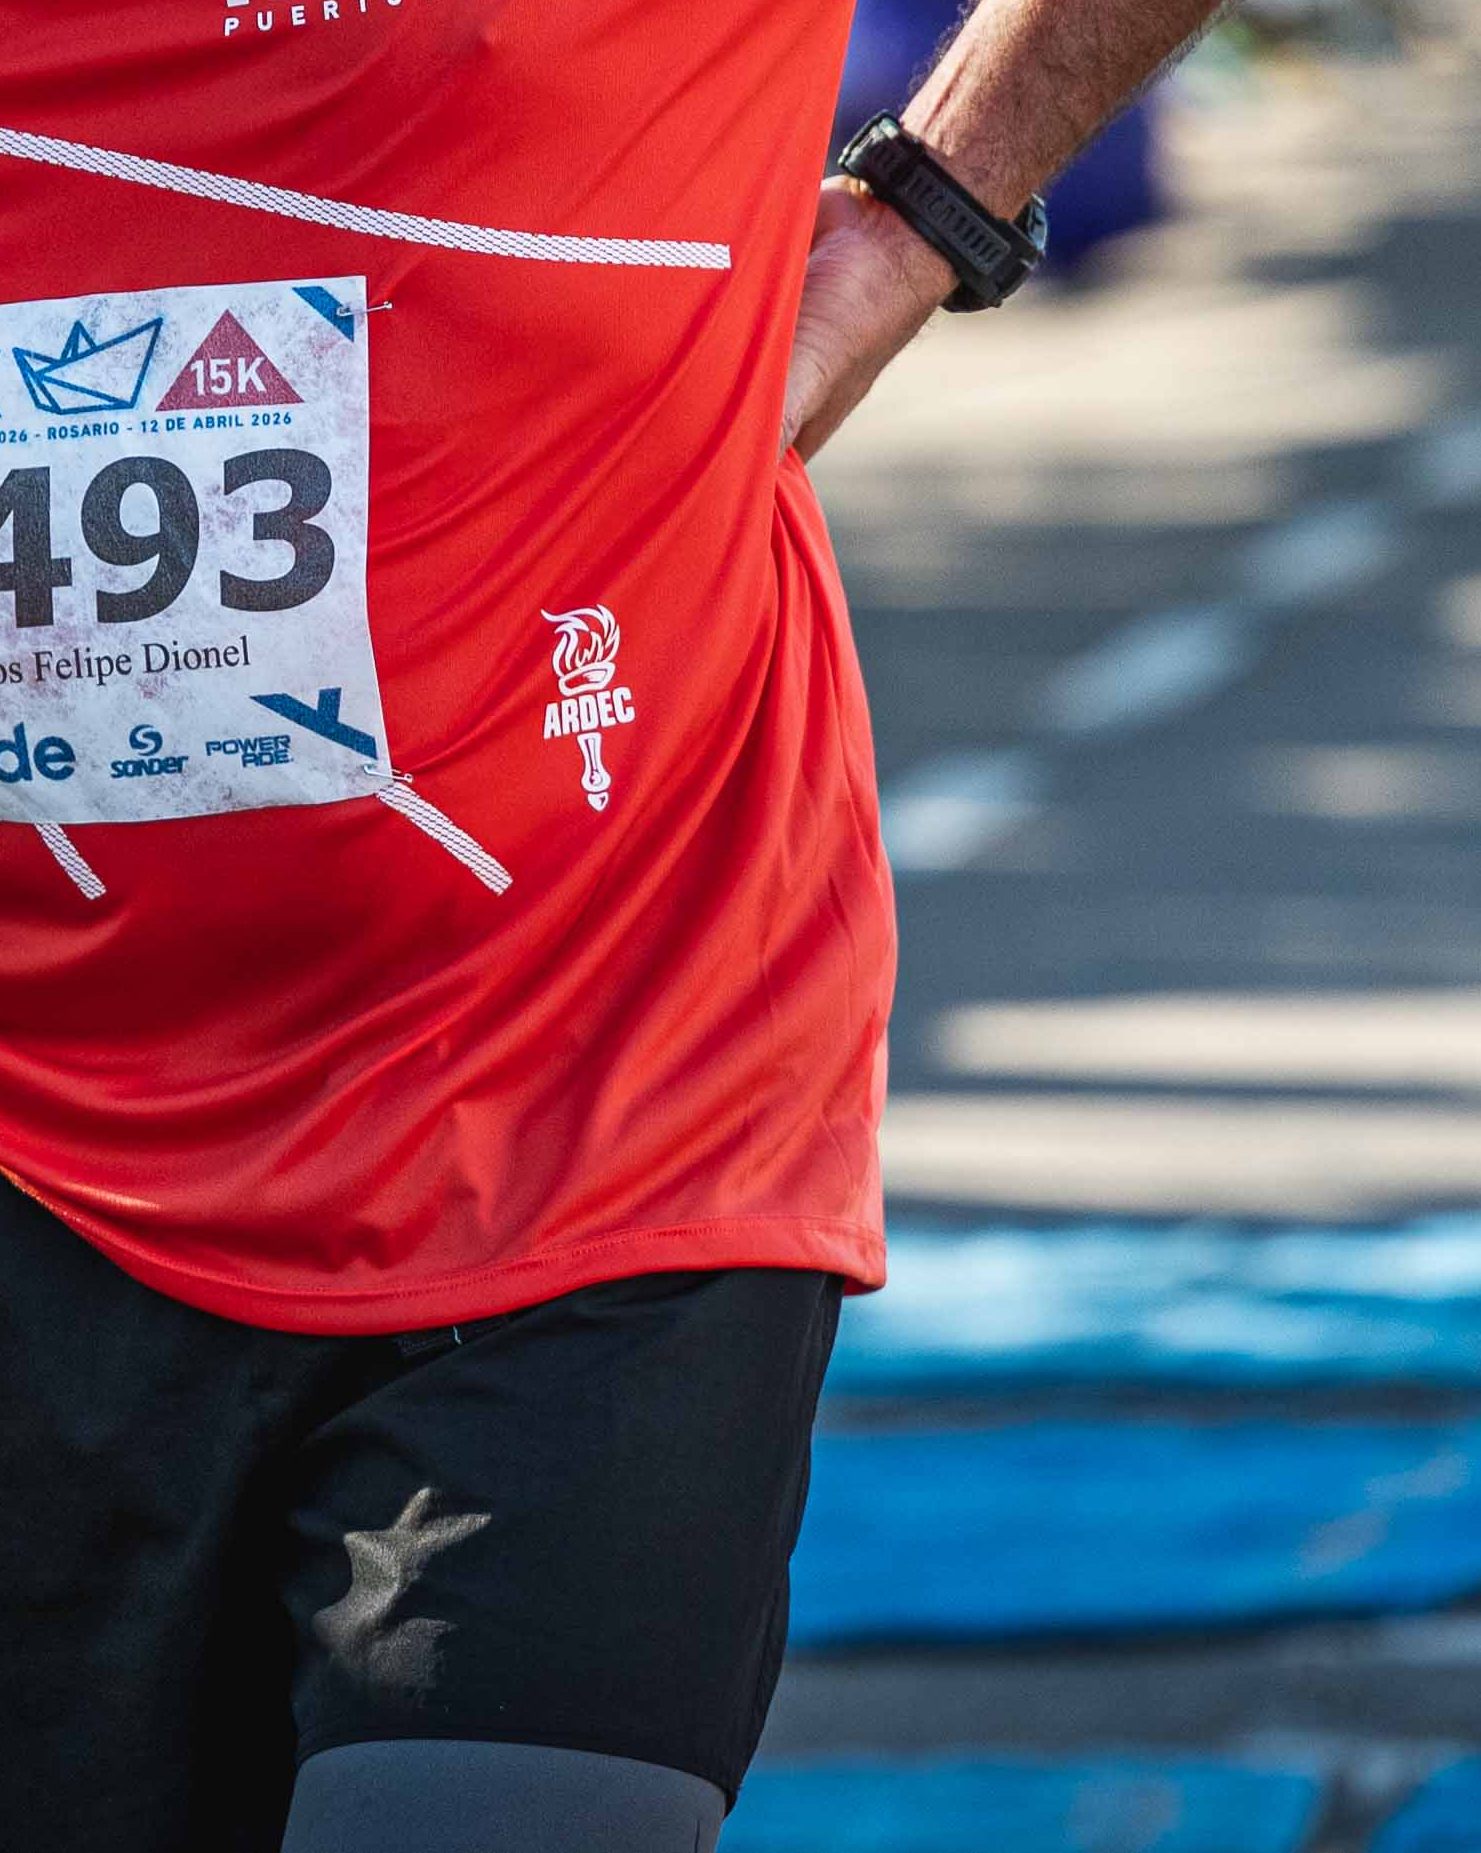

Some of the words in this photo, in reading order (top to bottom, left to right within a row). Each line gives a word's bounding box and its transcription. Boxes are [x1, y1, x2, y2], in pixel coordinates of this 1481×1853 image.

[189, 355, 268, 399] 15K
[47, 421, 120, 440] ROSARIO
[139, 420, 159, 434] 12
[166, 416, 186, 432] DE
[193, 413, 244, 430] ABRIL
[250, 411, 293, 426] 2026
[32, 647, 134, 687] Felipe
[142, 635, 252, 675] Dionel
[543, 686, 636, 740] ARDEC
[204, 734, 291, 757] POWER
